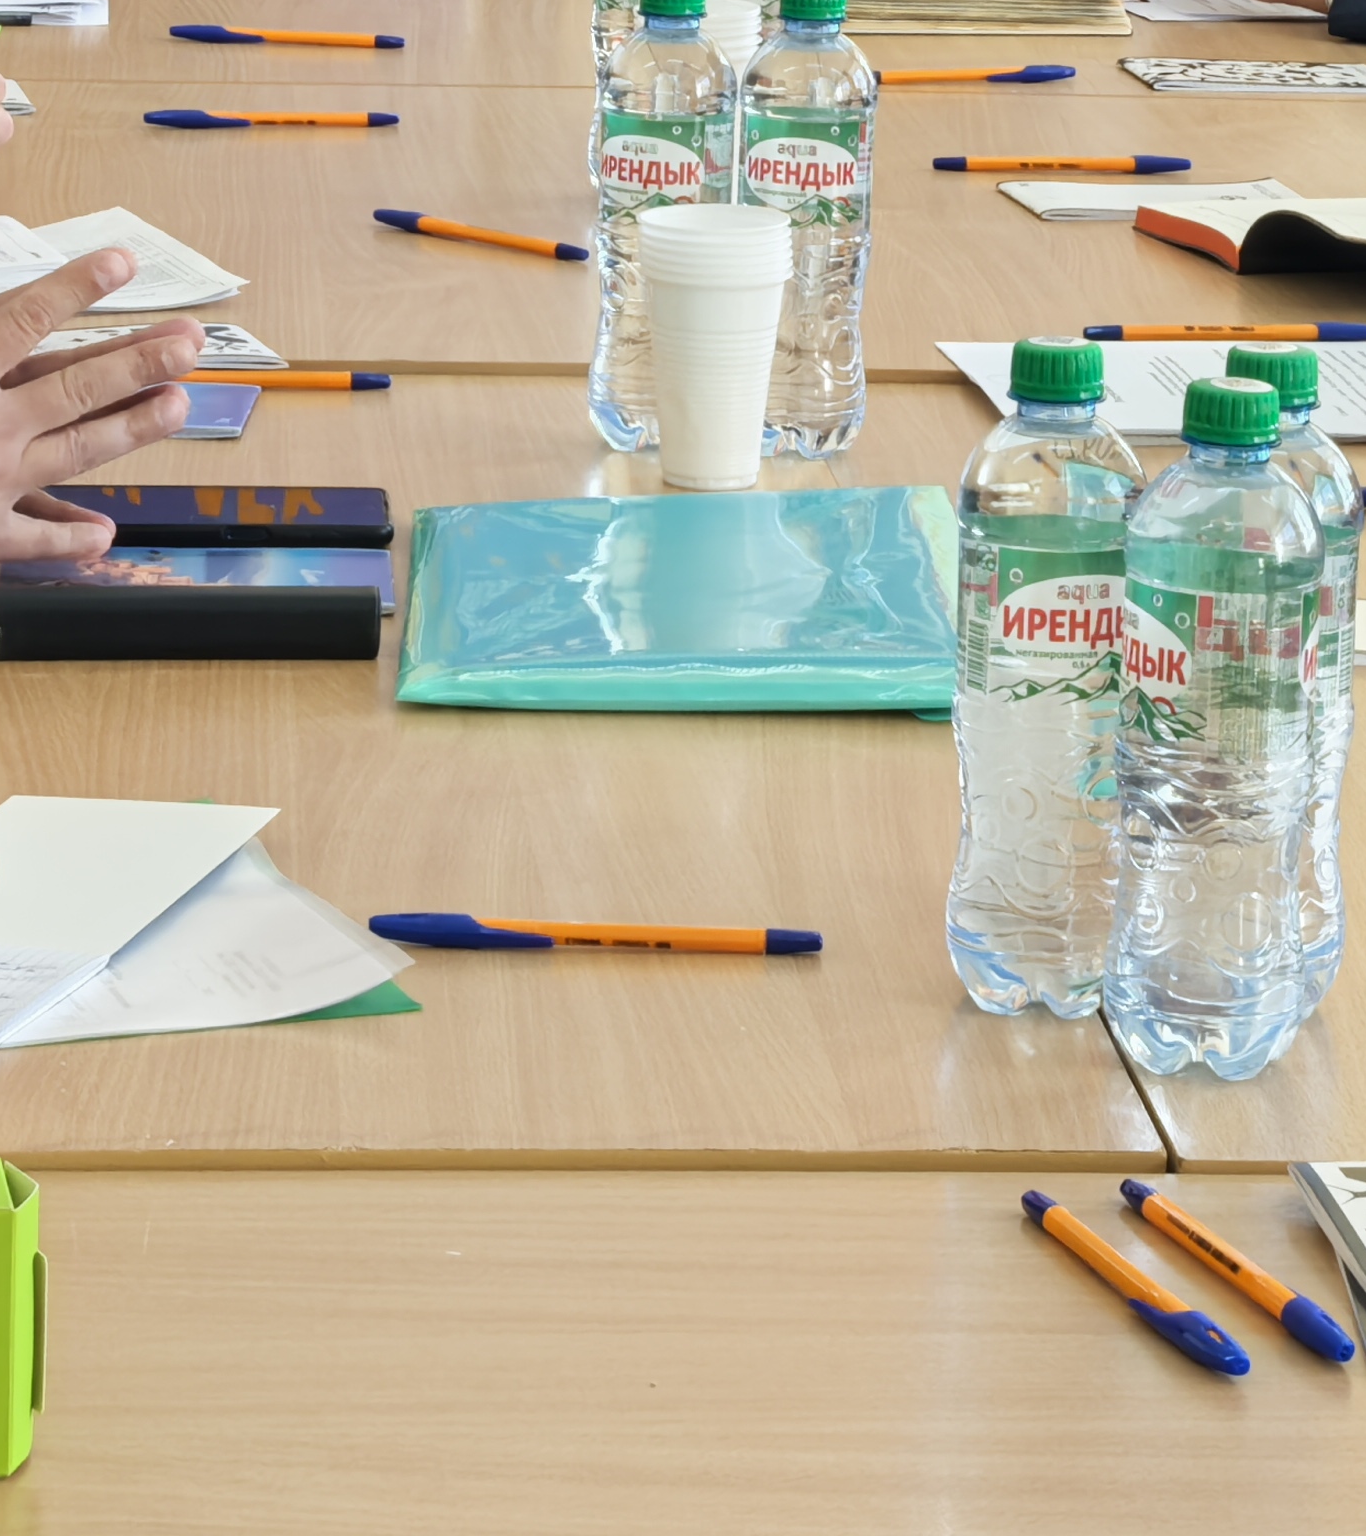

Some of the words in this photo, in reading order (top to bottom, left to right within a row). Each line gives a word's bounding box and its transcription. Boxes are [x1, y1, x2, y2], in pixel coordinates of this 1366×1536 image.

[601, 154, 702, 190] ИРЕНДЫК
[747, 155, 855, 192] ИРЕНДЫК
[1056, 582, 1111, 605] aqua
[1002, 604, 1125, 650] ИРЕНД
